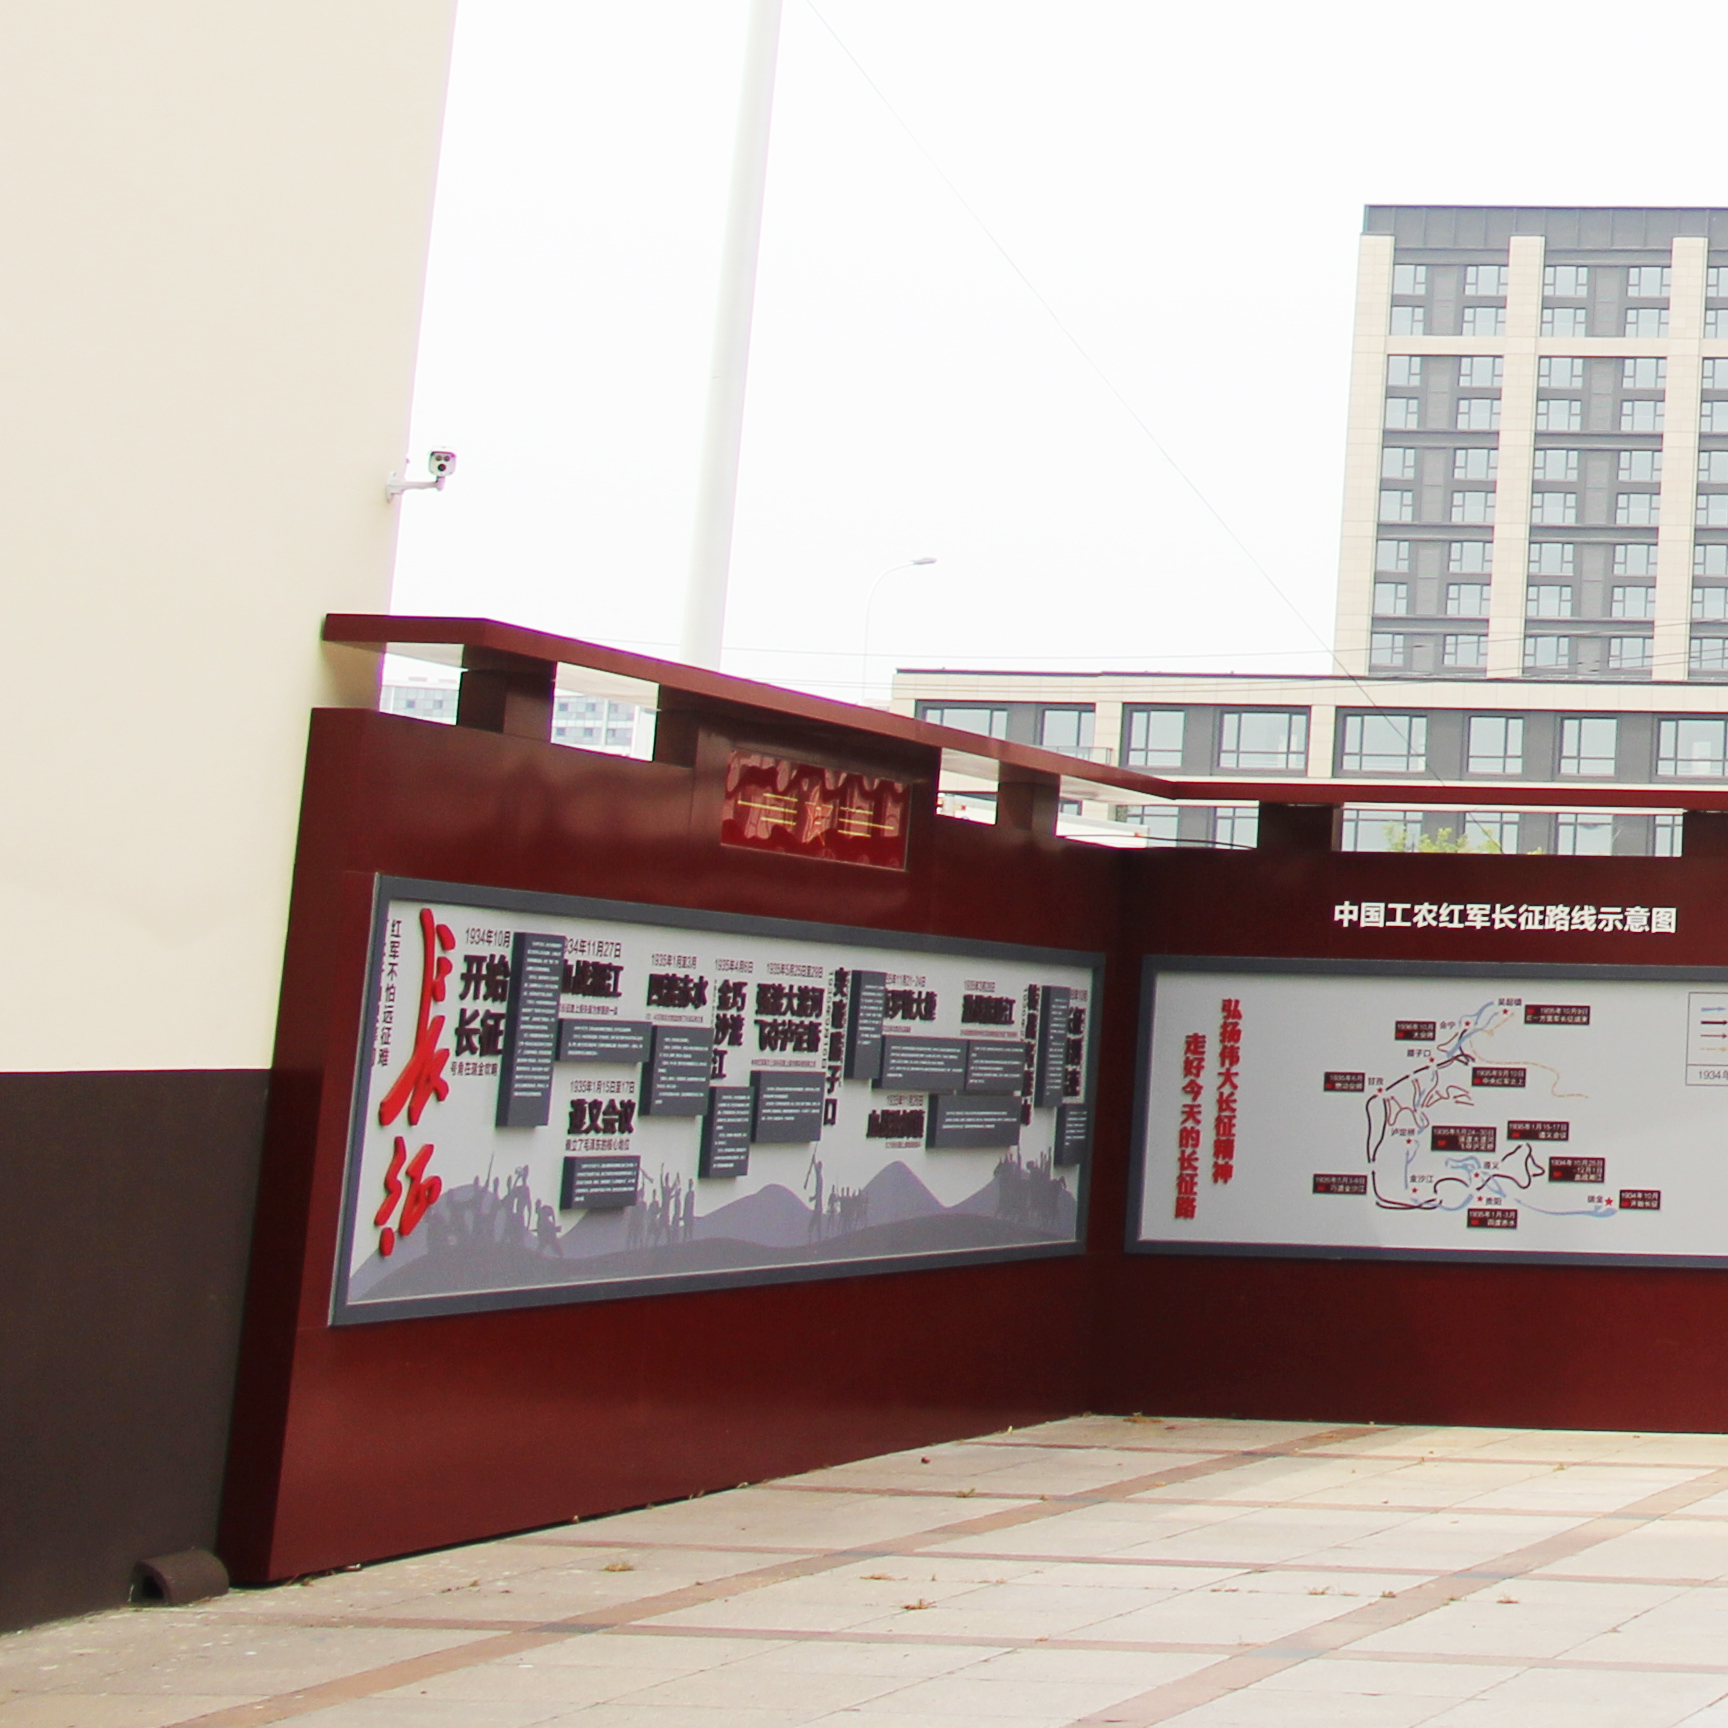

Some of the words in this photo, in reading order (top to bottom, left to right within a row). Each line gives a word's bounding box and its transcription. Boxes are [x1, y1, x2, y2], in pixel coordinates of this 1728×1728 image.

[1334, 901, 1678, 934] 中国工农红军长征路线示意图
[466, 928, 511, 948] 1934年10月
[459, 954, 511, 1003] 开始
[377, 920, 402, 1067] 红军不怕远征难
[455, 1008, 506, 1057] 长征
[1440, 1021, 1456, 1030] 会宁
[1212, 998, 1243, 1184] 弘扬伟大长征精神
[1368, 1077, 1384, 1085] 甘孜
[567, 1098, 636, 1135] 遵义会议
[1175, 1033, 1206, 1220] 走好今天的长征路
[1391, 1128, 1415, 1137] 泸定桥
[1538, 1131, 1567, 1140] 遵义会议
[1483, 1161, 1499, 1170] 遵义
[1410, 1175, 1433, 1183] 金沙江
